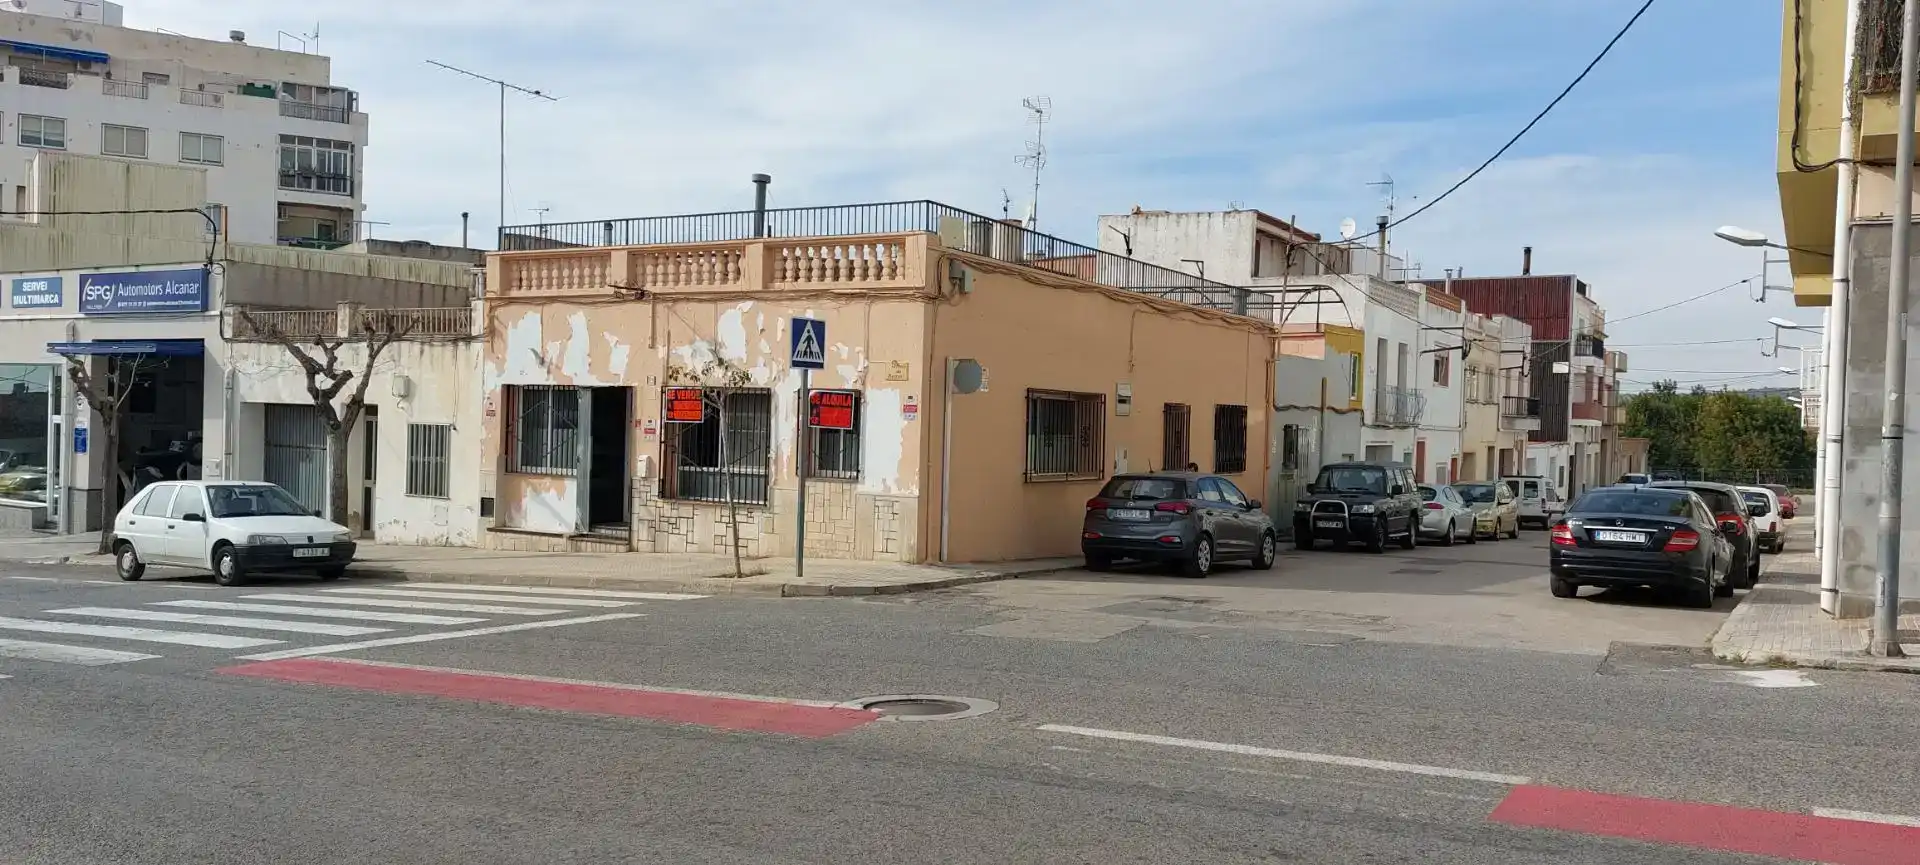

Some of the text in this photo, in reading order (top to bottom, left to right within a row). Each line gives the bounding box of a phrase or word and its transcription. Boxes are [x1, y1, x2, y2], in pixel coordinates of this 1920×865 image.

[22, 281, 48, 292] SERVEI
[86, 285, 111, 301] SPG
[117, 280, 200, 297] Automotors Alcanar
[13, 294, 59, 305] MULTIMARCA
[821, 393, 852, 407] ALQUILA
